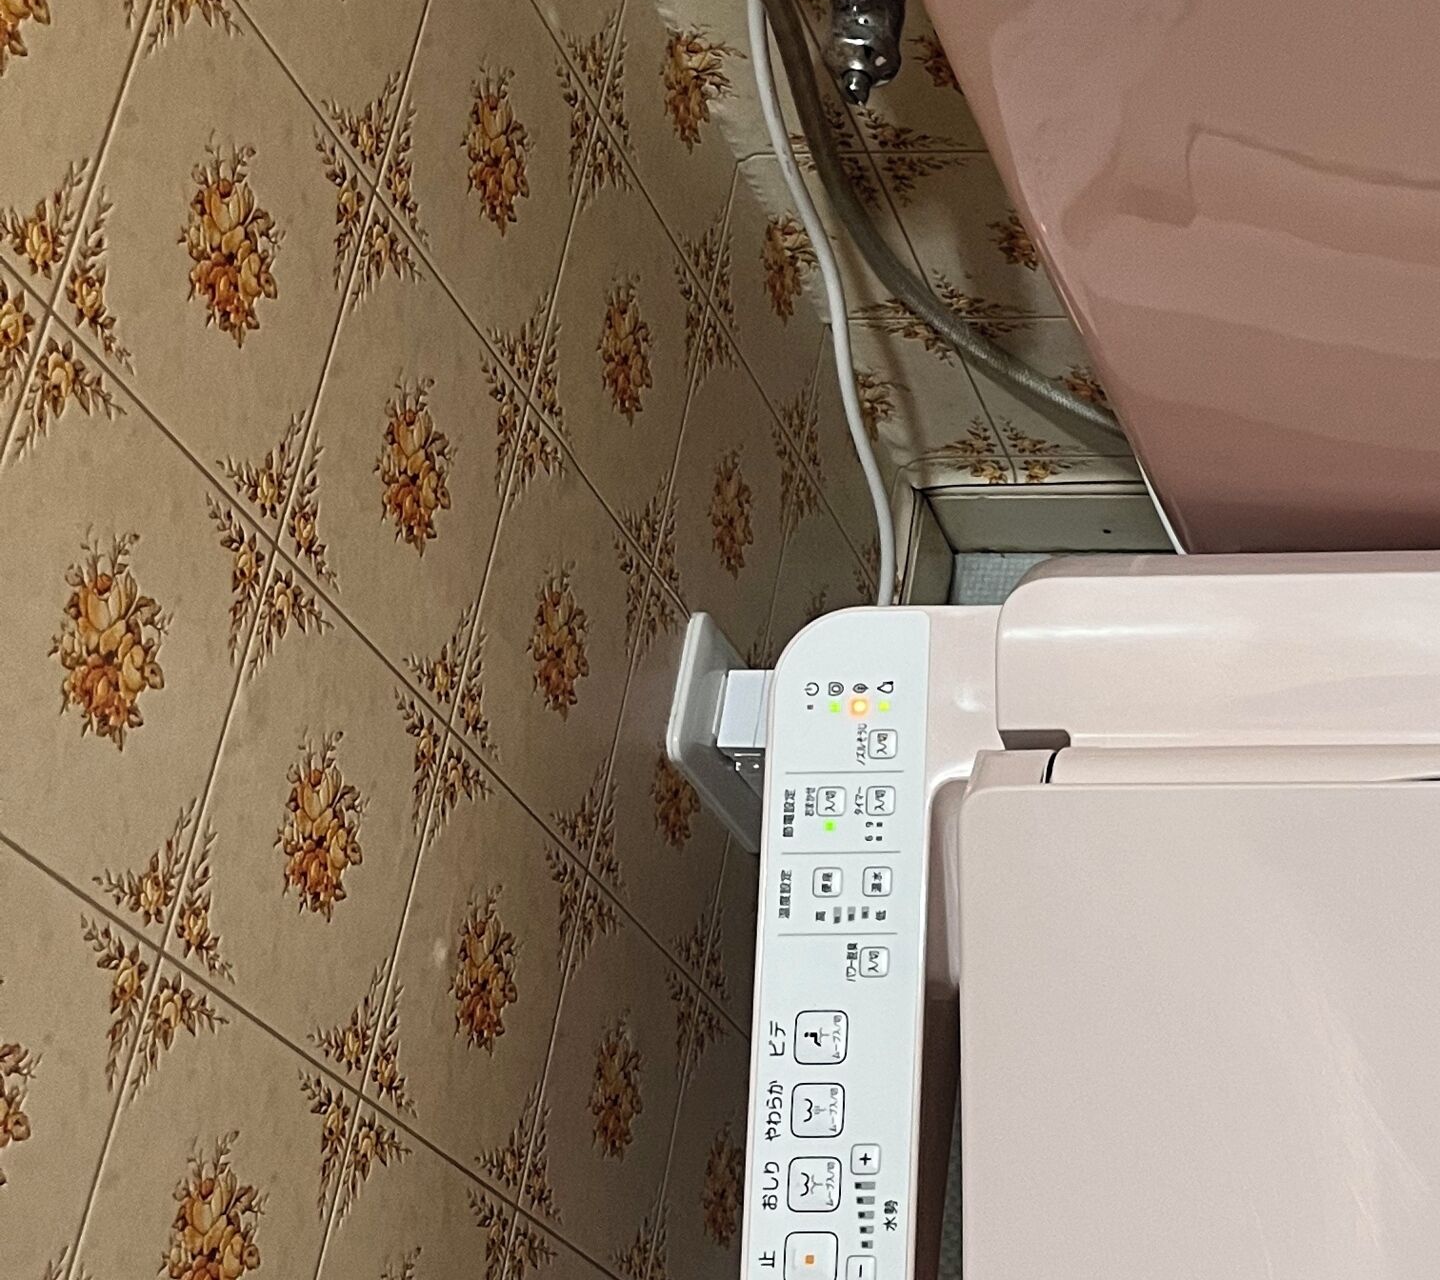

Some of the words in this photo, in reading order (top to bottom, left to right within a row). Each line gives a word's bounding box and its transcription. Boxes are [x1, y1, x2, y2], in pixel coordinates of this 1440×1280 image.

[782, 789, 796, 838] 節電設定
[804, 787, 816, 816] おまかせ
[854, 786, 865, 815] タイマー
[778, 869, 792, 919] 温度設定
[822, 872, 834, 893] 便座
[871, 872, 883, 893] 温水
[875, 909, 887, 922] 低
[764, 1080, 783, 1142] やわらか
[761, 1162, 780, 1210] おしり
[882, 1199, 898, 1232] 水勢
[758, 1250, 776, 1269] 止
